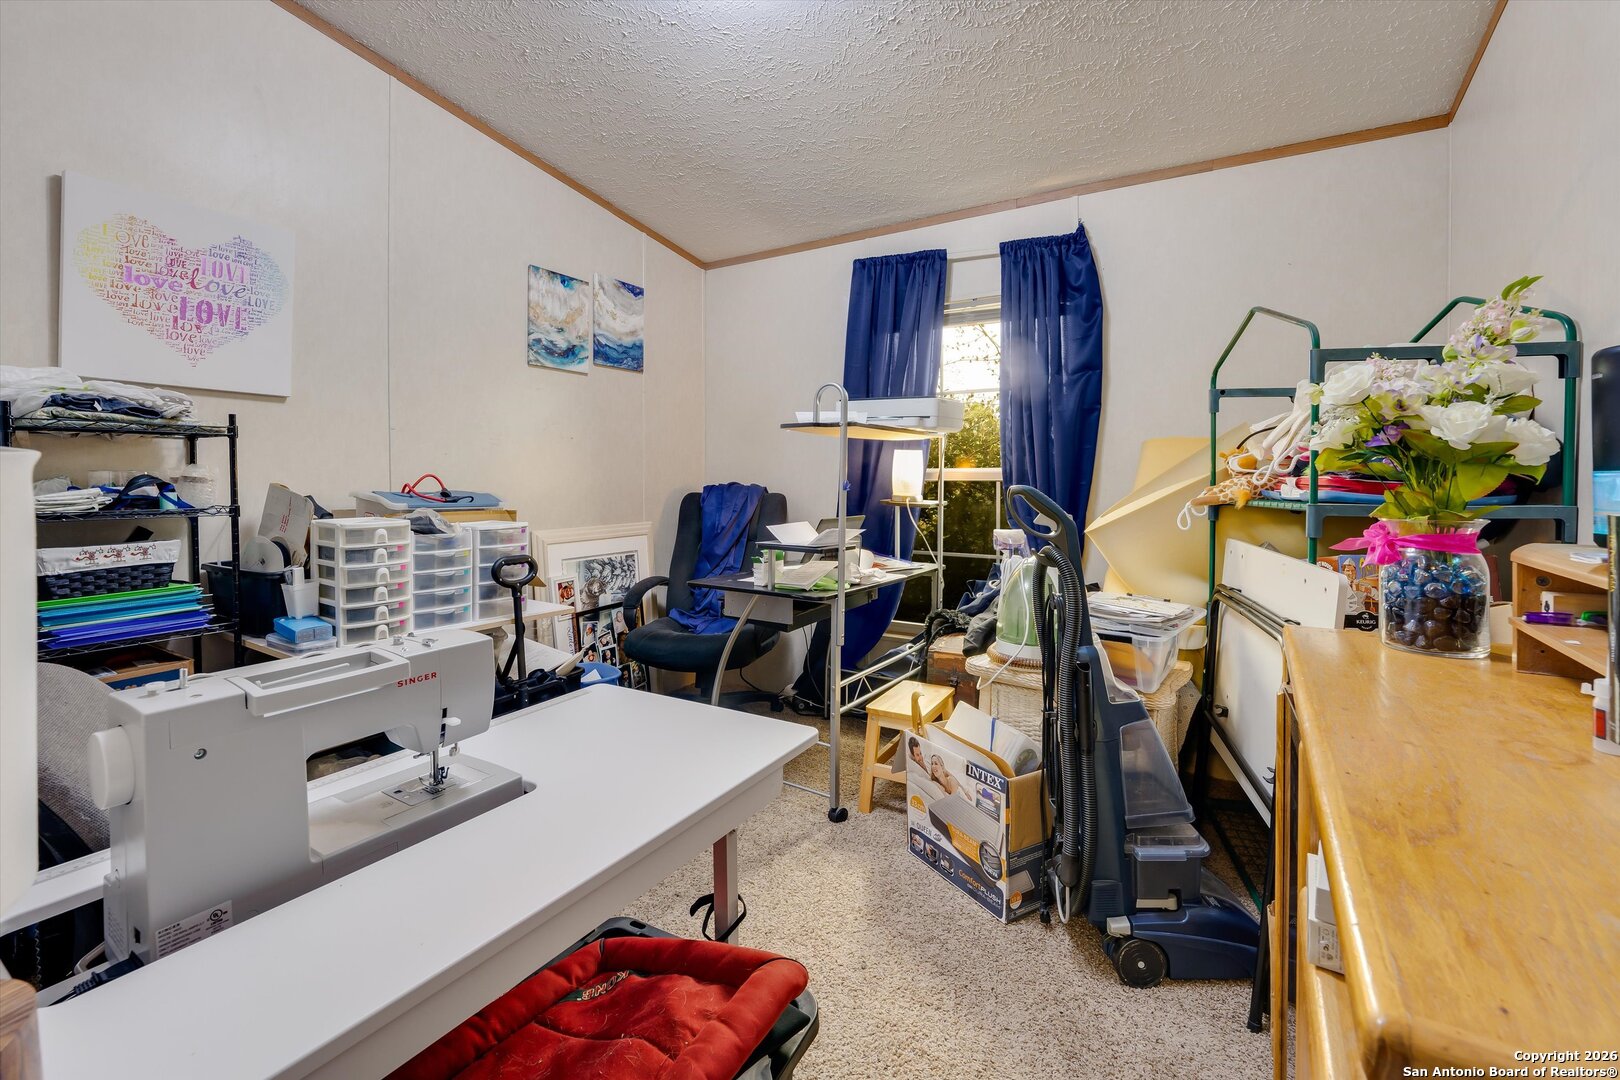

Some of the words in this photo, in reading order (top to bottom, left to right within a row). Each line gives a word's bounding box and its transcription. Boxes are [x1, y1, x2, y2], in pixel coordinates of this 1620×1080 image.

[208, 248, 231, 262] love
[123, 264, 184, 292] love
[187, 267, 248, 299] love
[105, 291, 130, 302] love
[247, 296, 276, 311] LOVE
[166, 329, 197, 344] love
[184, 344, 207, 356] love
[397, 671, 437, 688] SINGER
[967, 763, 1002, 790] INTEX
